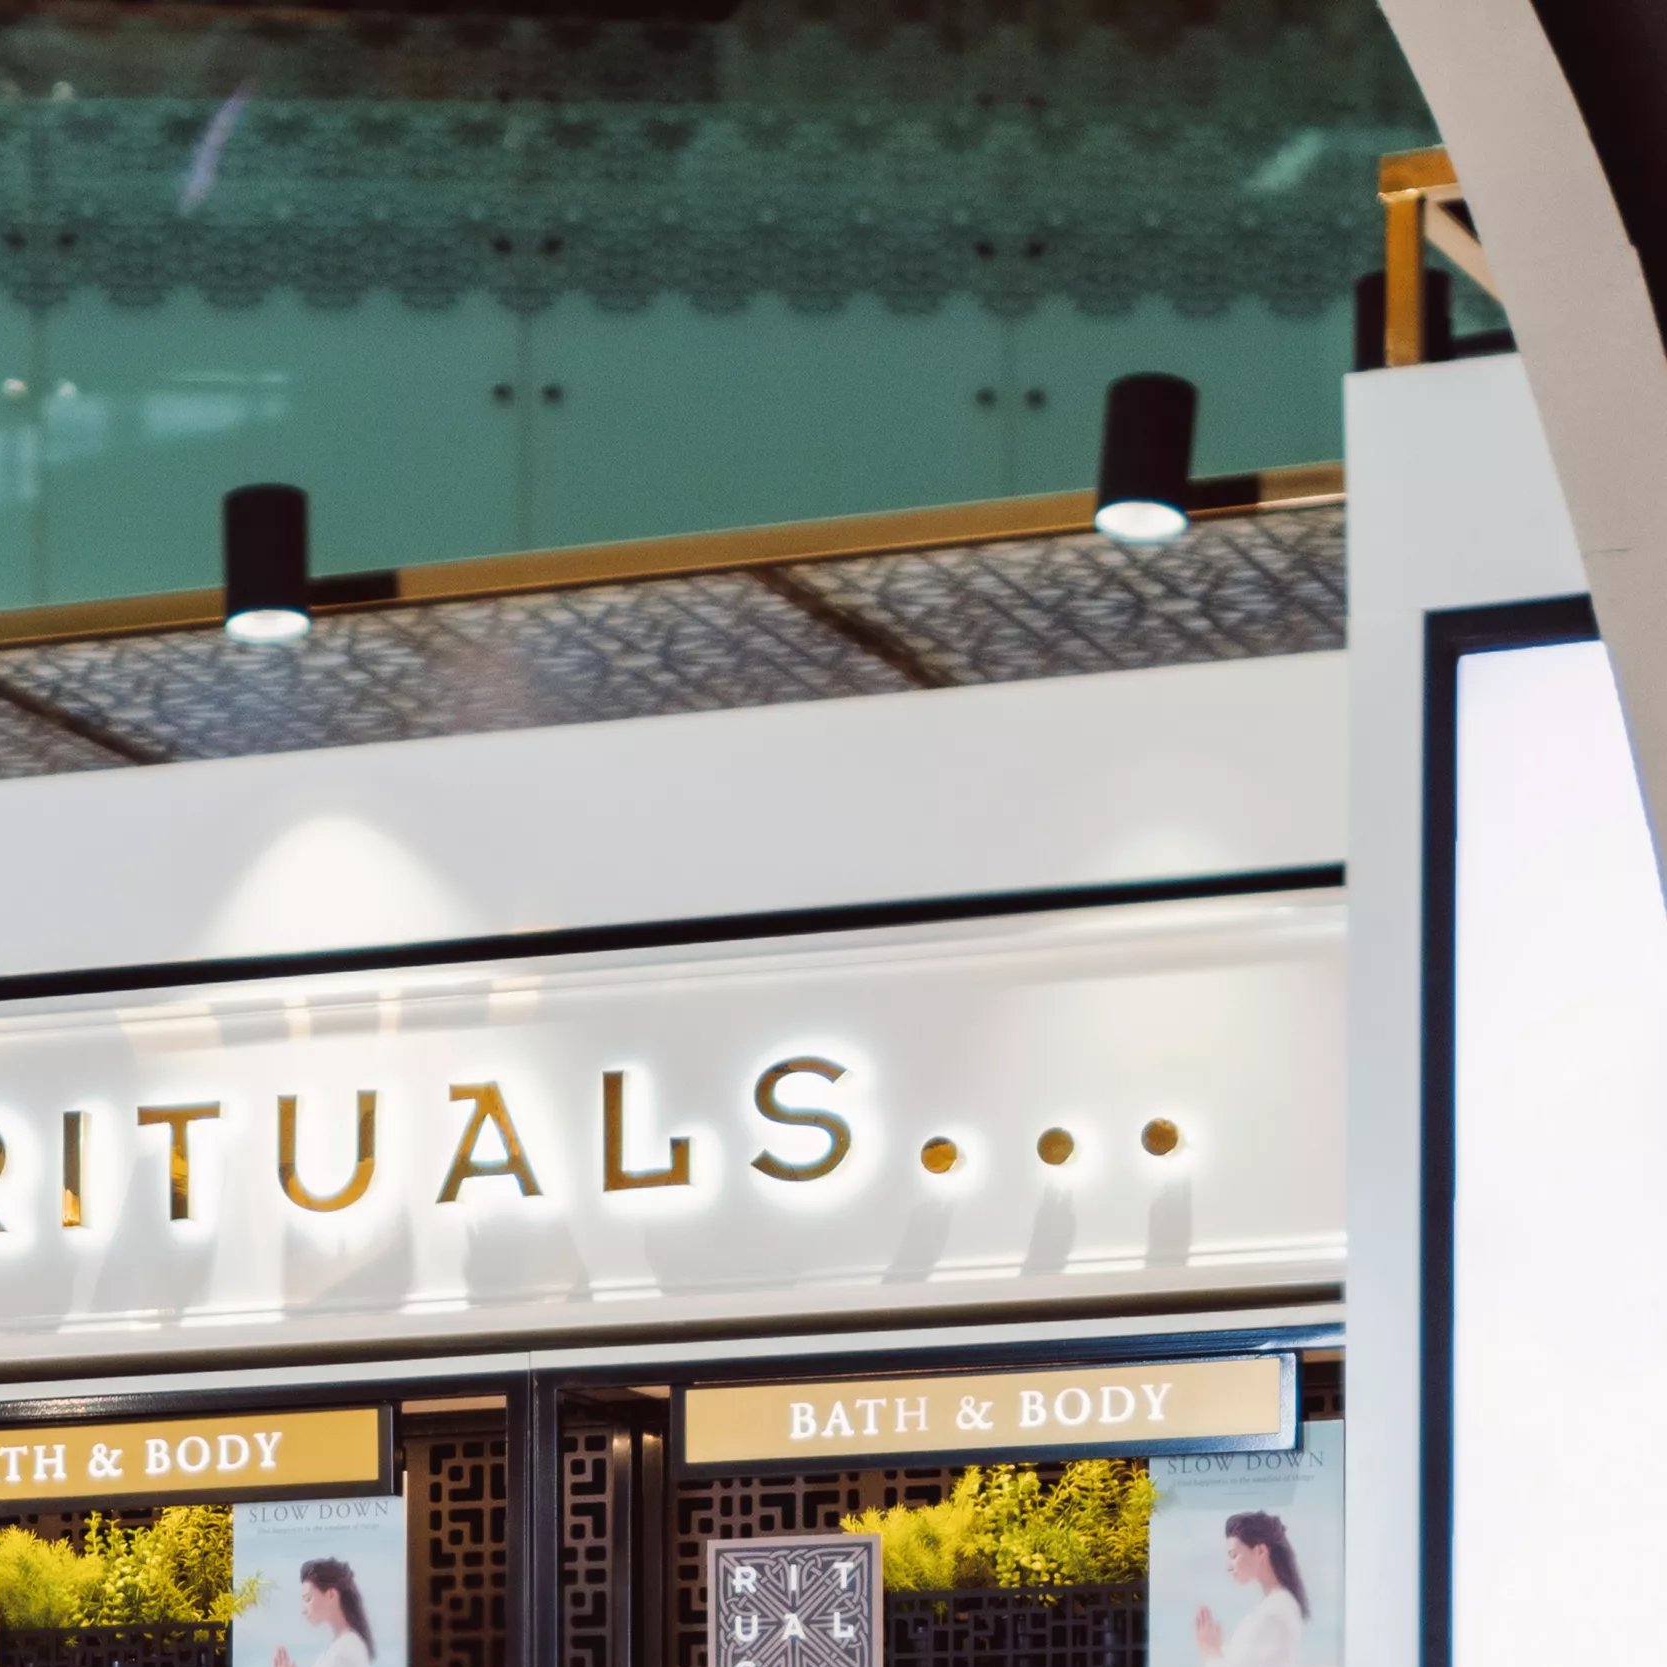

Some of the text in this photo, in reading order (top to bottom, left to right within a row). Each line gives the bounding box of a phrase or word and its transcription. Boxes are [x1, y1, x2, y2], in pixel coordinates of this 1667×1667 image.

[789, 1383, 1173, 1439] BATH & BODY
[88, 1441, 123, 1478] &
[145, 1432, 283, 1476] BODY
[1167, 1451, 1325, 1474] SLOW DOWN
[249, 1501, 389, 1523] SLOW DOWN
